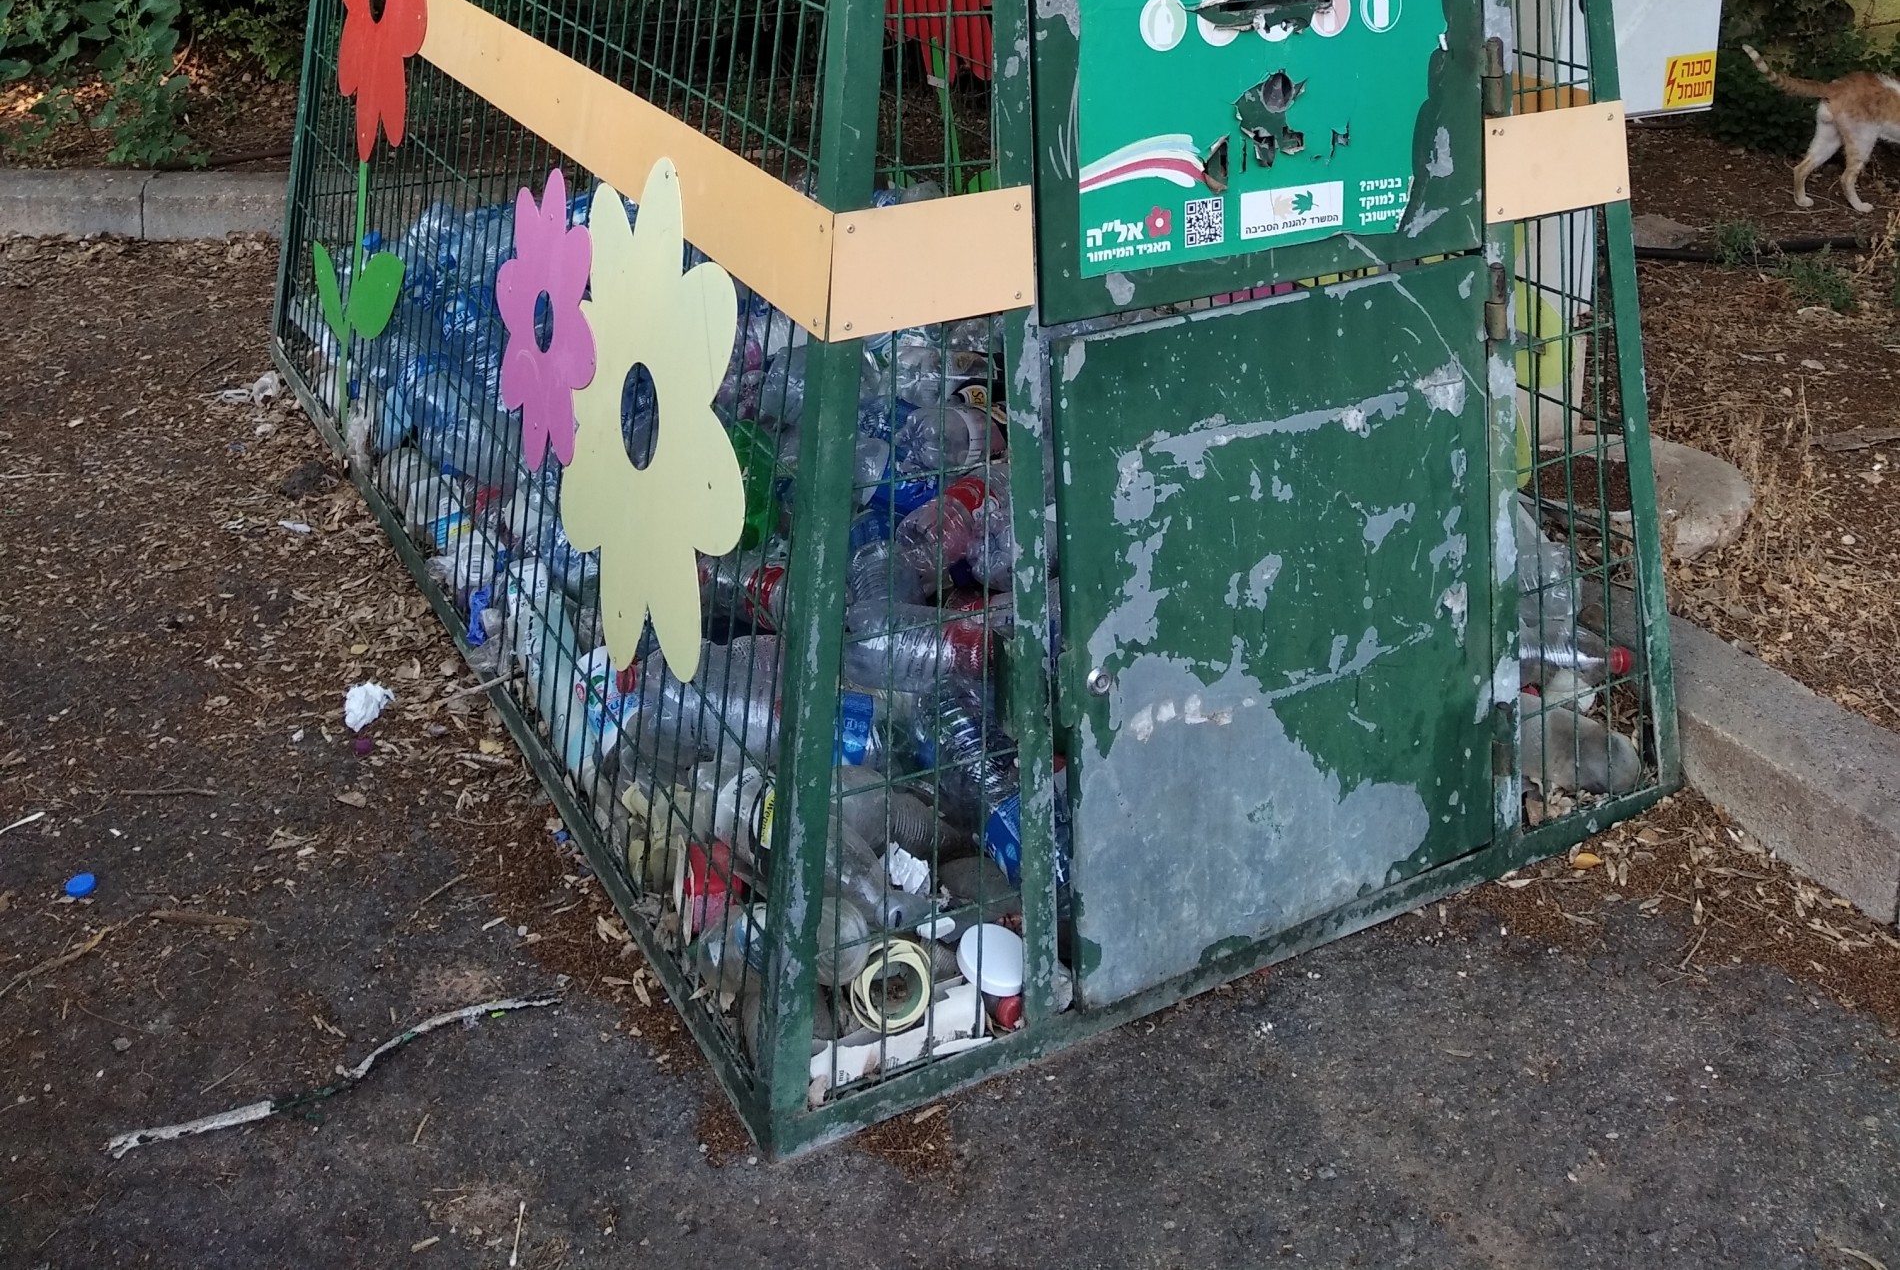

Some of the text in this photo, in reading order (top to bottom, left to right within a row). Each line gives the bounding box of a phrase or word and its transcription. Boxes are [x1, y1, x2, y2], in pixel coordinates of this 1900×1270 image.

[1681, 59, 1712, 78] סכנה
[1677, 80, 1713, 100] חשמל
[1359, 177, 1402, 192] בבעיה?
[1358, 191, 1395, 210] למוקד
[1245, 214, 1339, 234] המשרד להגנת הסביבה
[1086, 240, 1171, 263] תאגיד המיחזור
